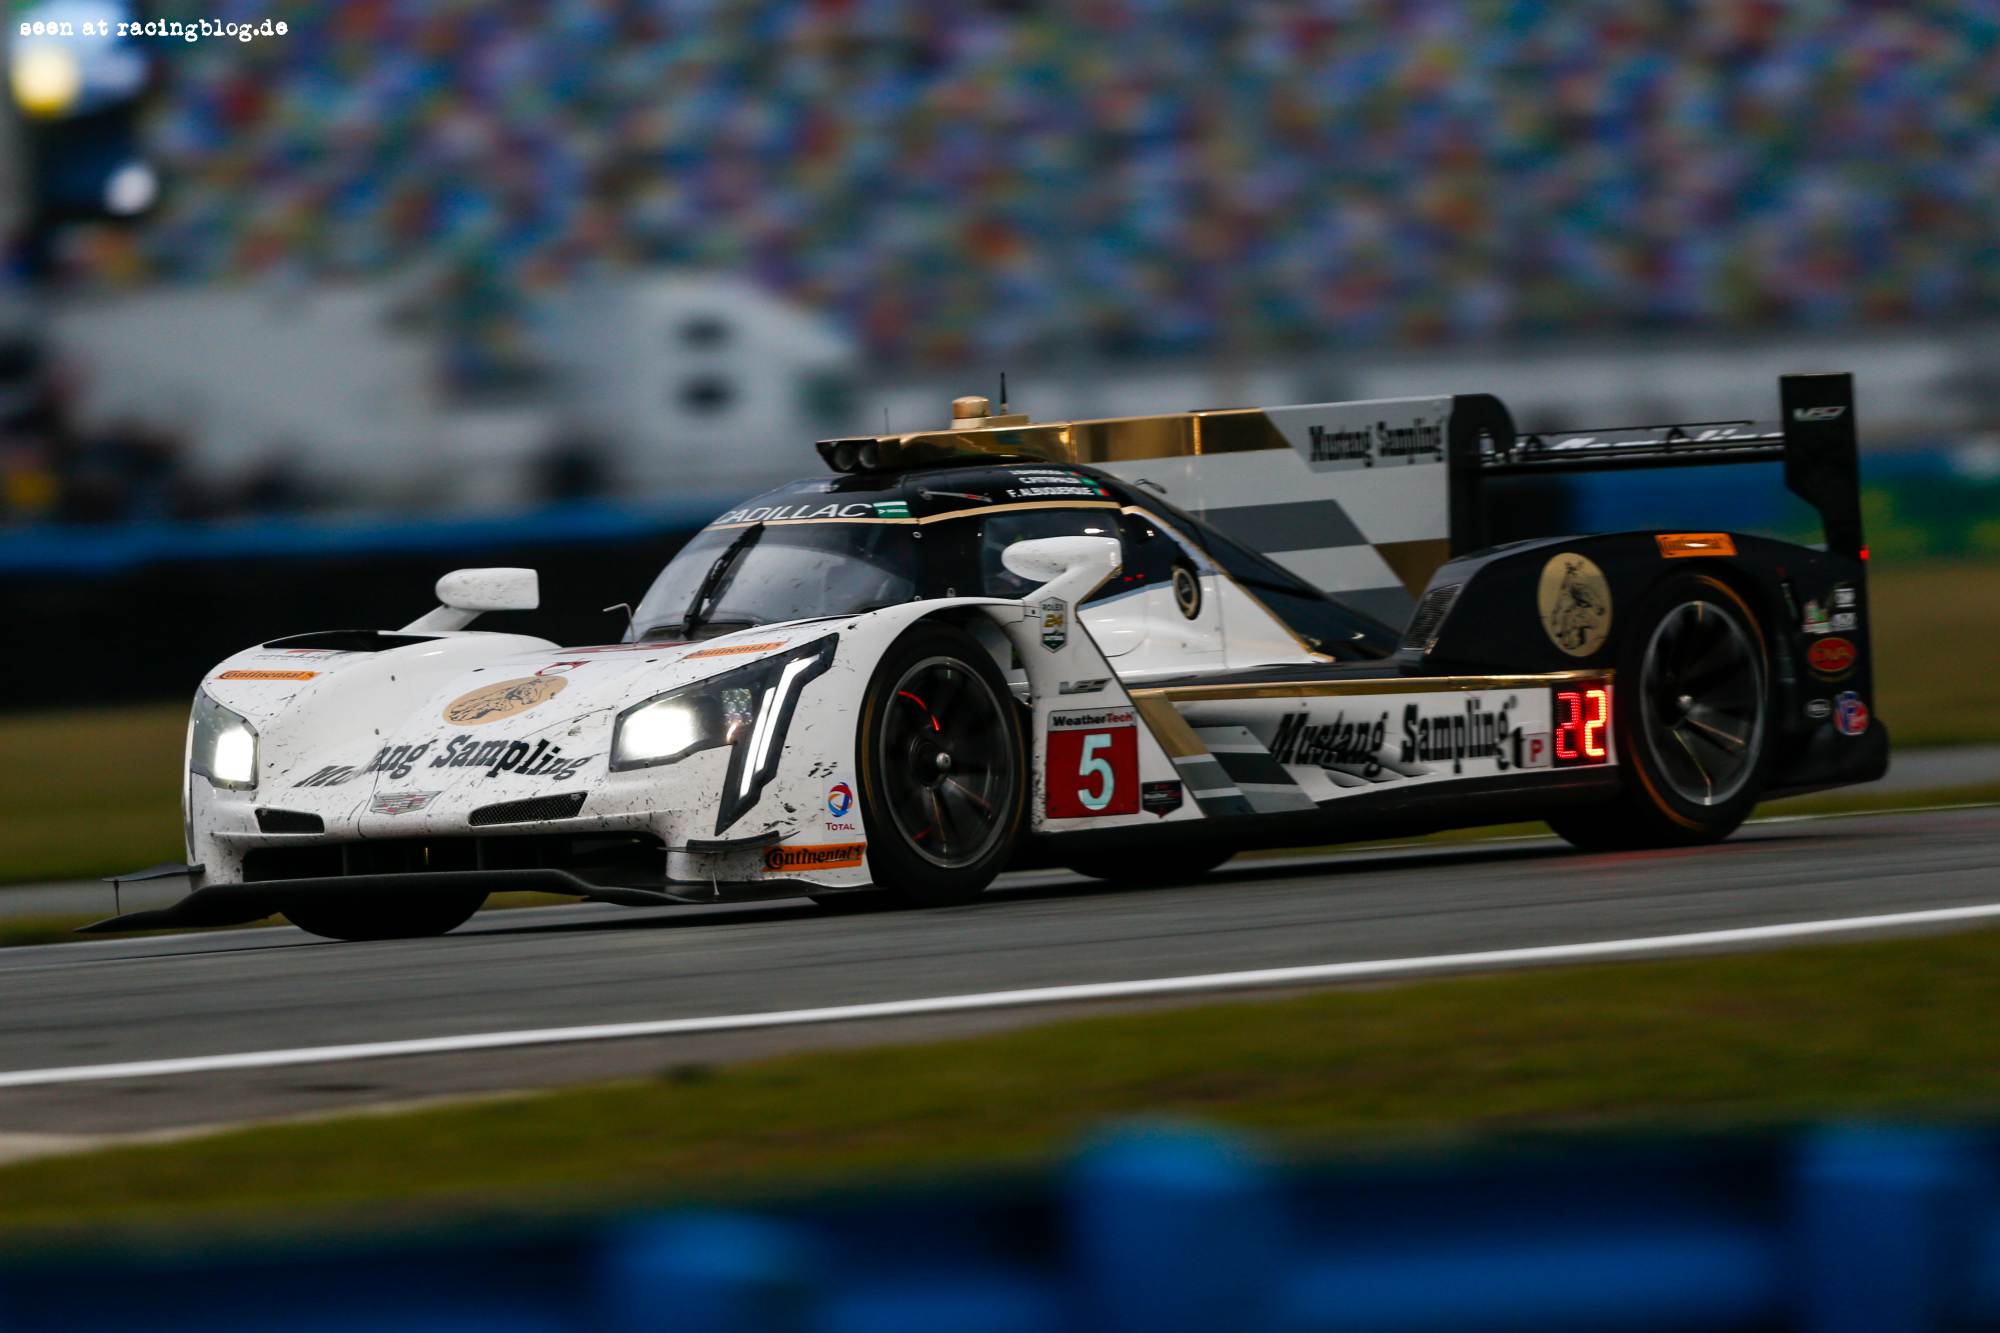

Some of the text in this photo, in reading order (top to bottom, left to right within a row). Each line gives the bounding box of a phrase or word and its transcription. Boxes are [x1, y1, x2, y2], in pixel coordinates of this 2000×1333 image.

[713, 503, 873, 526] CADILLAC
[1052, 711, 1134, 727] WeatherTech
[1556, 689, 1607, 759] 22
[1269, 699, 1510, 777] Mustang Sampling
[293, 734, 592, 787] Muang Sampling
[1530, 739, 1543, 762] P
[1077, 733, 1115, 811] 5
[825, 822, 855, 831] TOTAL
[764, 846, 851, 870] Continental
